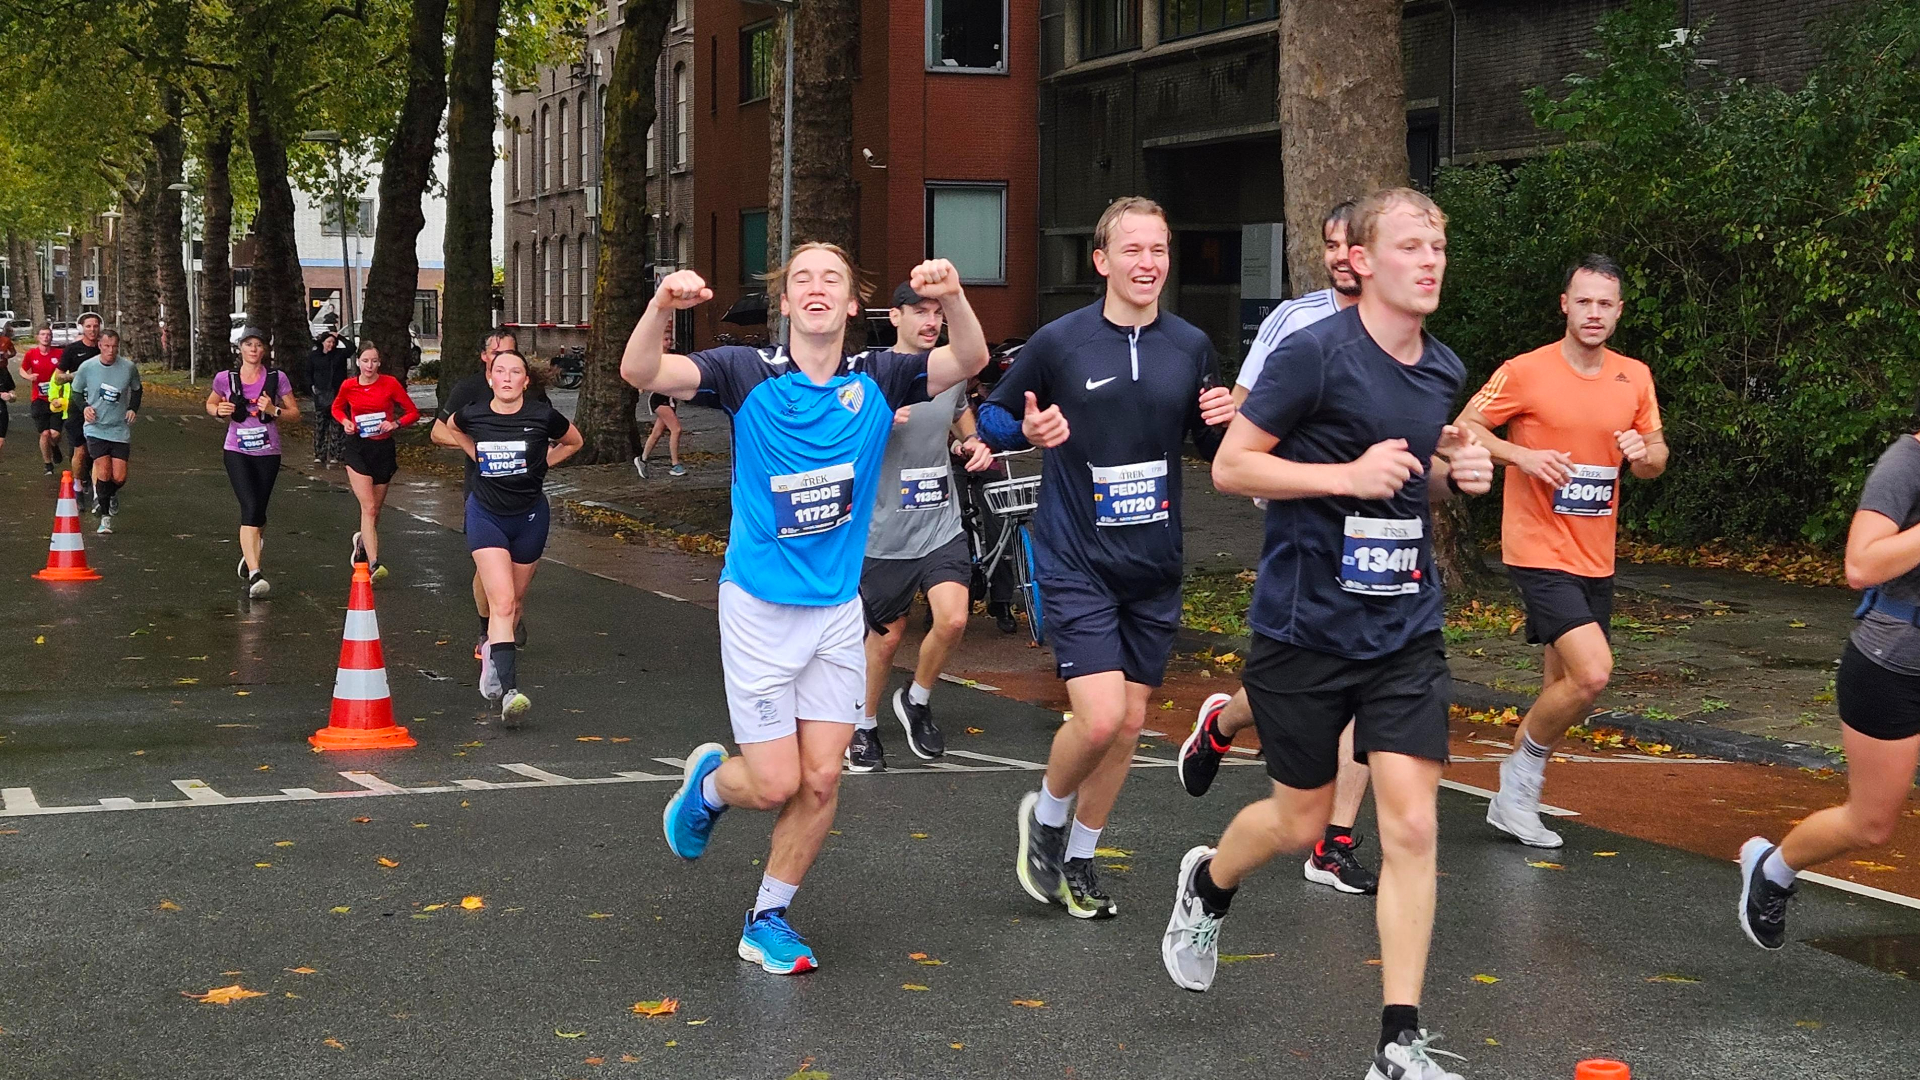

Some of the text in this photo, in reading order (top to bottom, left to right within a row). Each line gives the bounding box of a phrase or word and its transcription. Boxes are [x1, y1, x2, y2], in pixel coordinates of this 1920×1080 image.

[1258, 306, 1270, 318] 170
[485, 452, 517, 460] TEDDY
[802, 474, 829, 487] TREK
[1120, 469, 1145, 481] TREK
[1580, 468, 1602, 478] TREK
[917, 479, 940, 490] GIEL
[1109, 479, 1156, 497] FEDDE
[1560, 482, 1613, 502] 13016
[790, 484, 841, 506] FEDDE
[795, 502, 840, 523] 11722
[1111, 496, 1156, 514] 11720
[1353, 546, 1419, 573] 13411
